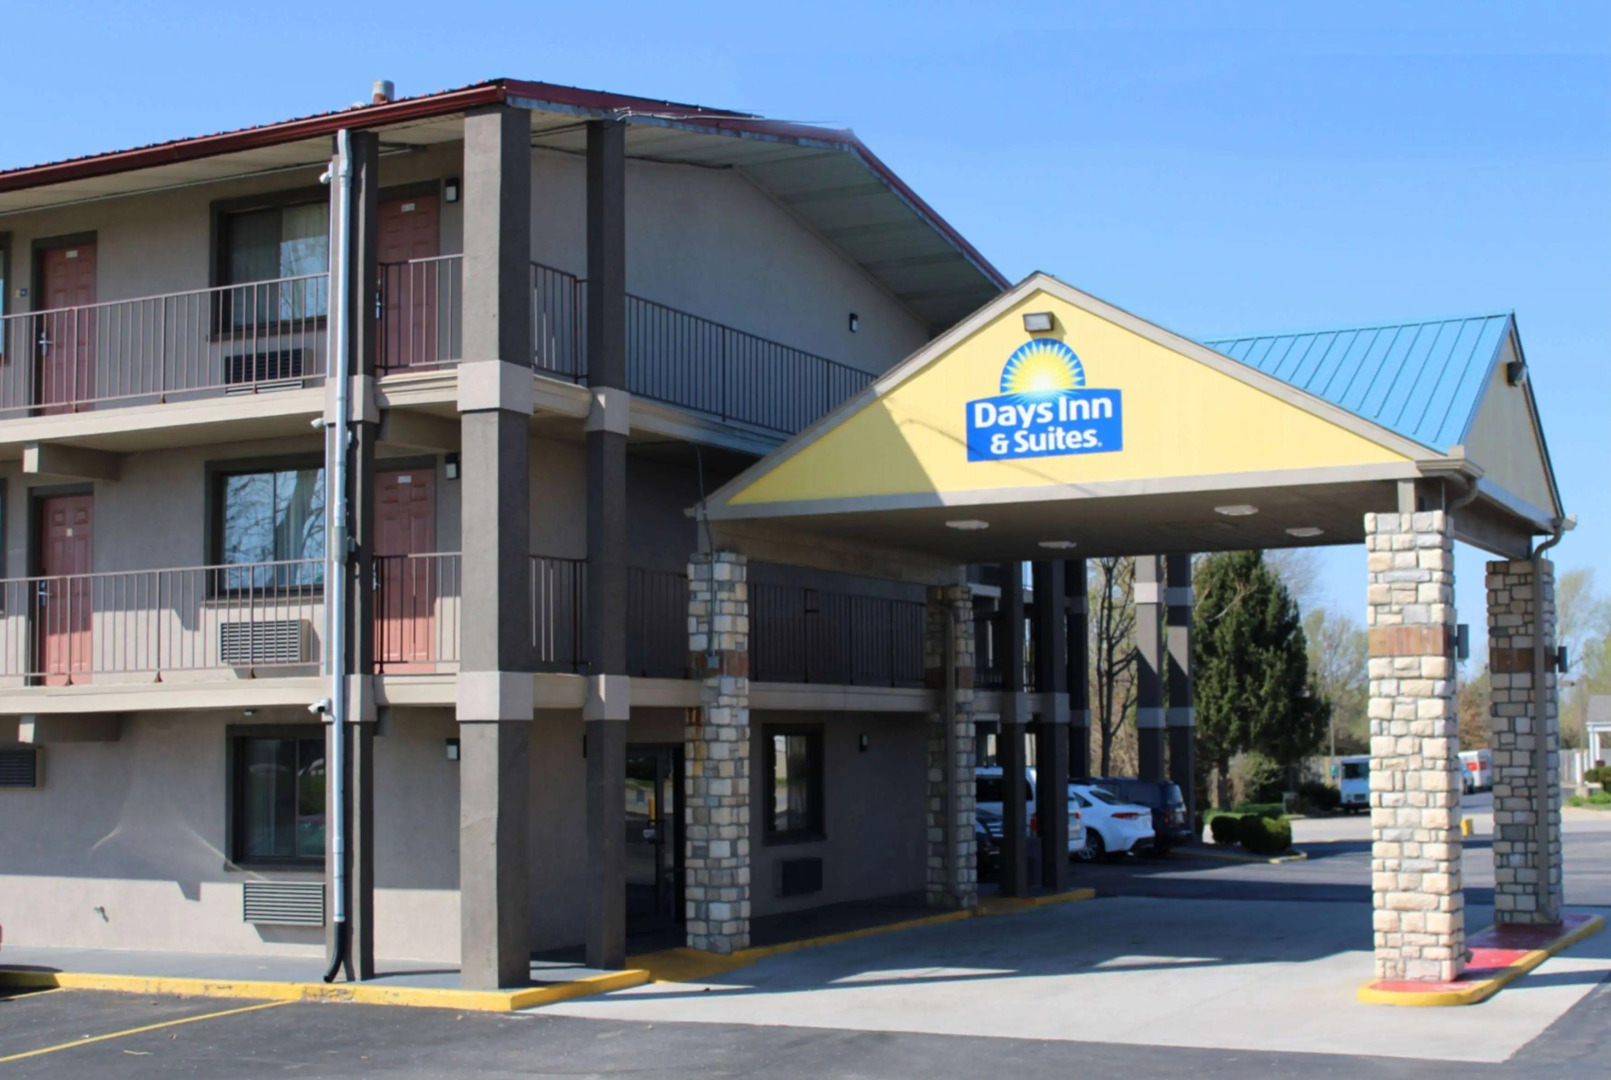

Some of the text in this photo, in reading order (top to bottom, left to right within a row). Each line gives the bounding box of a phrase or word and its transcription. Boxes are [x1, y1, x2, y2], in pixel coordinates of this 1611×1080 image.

[974, 396, 1113, 429] Days Inn
[990, 426, 1098, 454] & Suites
